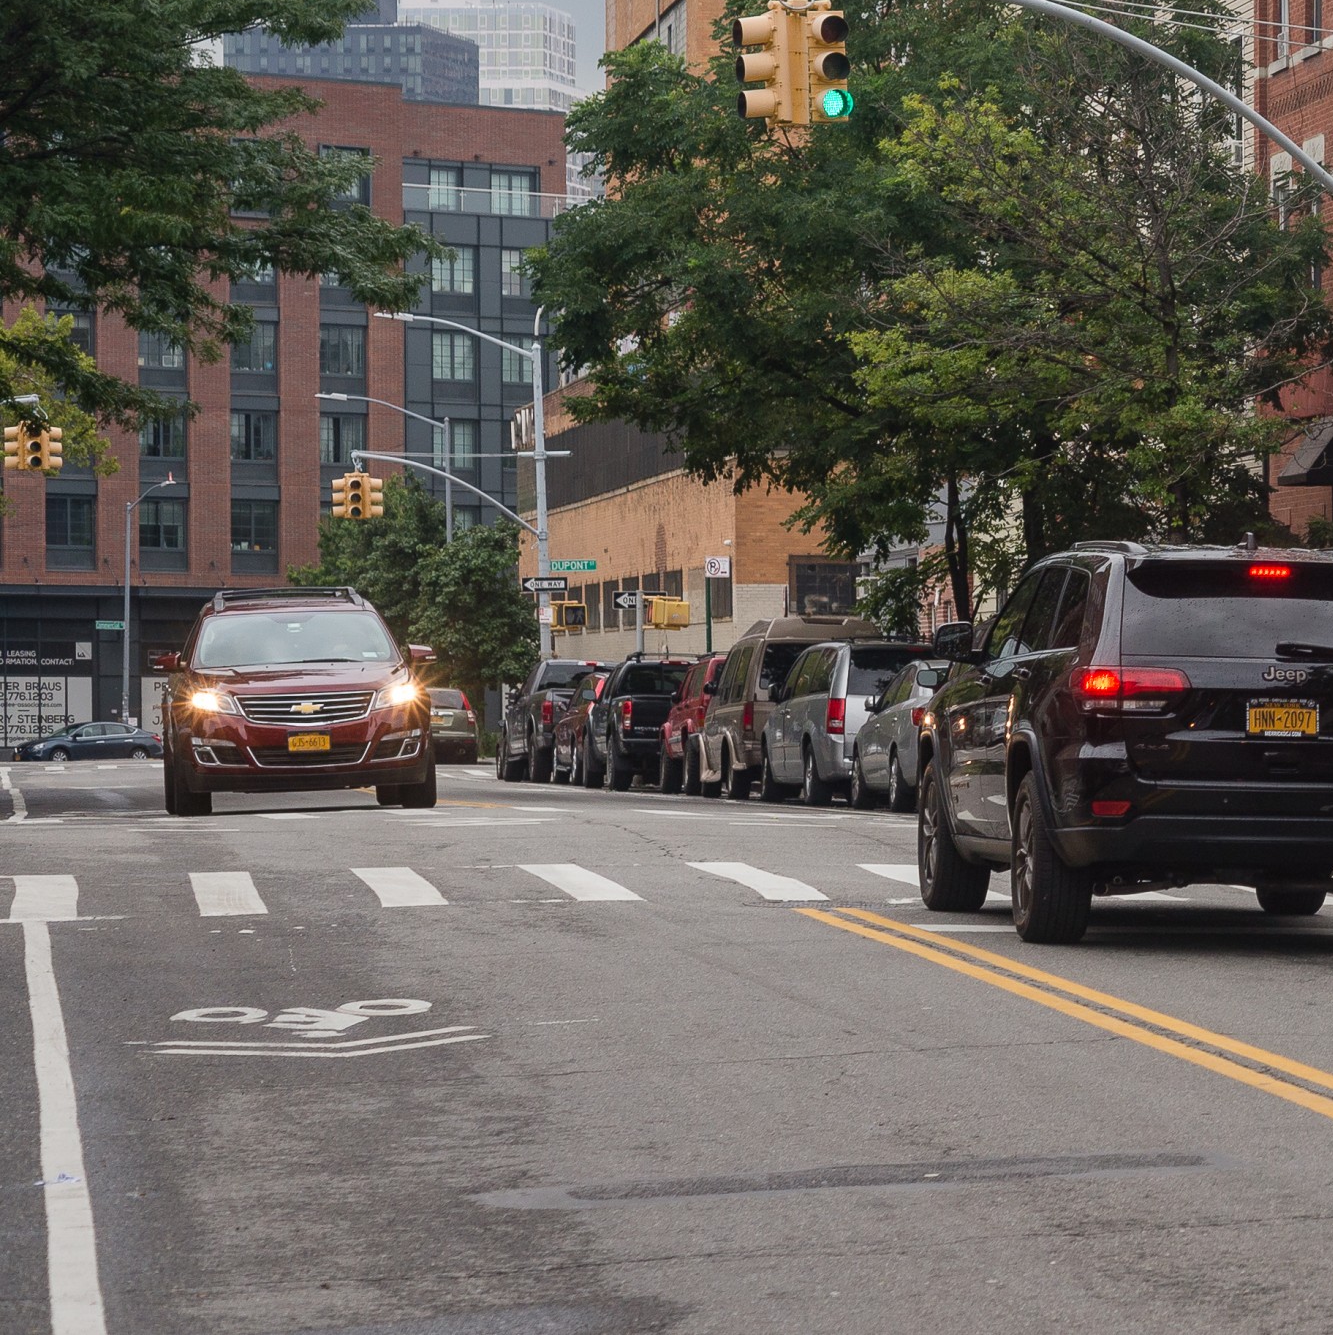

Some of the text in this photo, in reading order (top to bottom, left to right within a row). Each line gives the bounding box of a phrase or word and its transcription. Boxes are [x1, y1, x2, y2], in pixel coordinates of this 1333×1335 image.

[551, 561, 588, 570] DUPONT
[1263, 666, 1307, 683] Jeep
[25, 682, 62, 691] BRAUS
[1254, 710, 1276, 728] HNN
[1283, 711, 1312, 729] 2097
